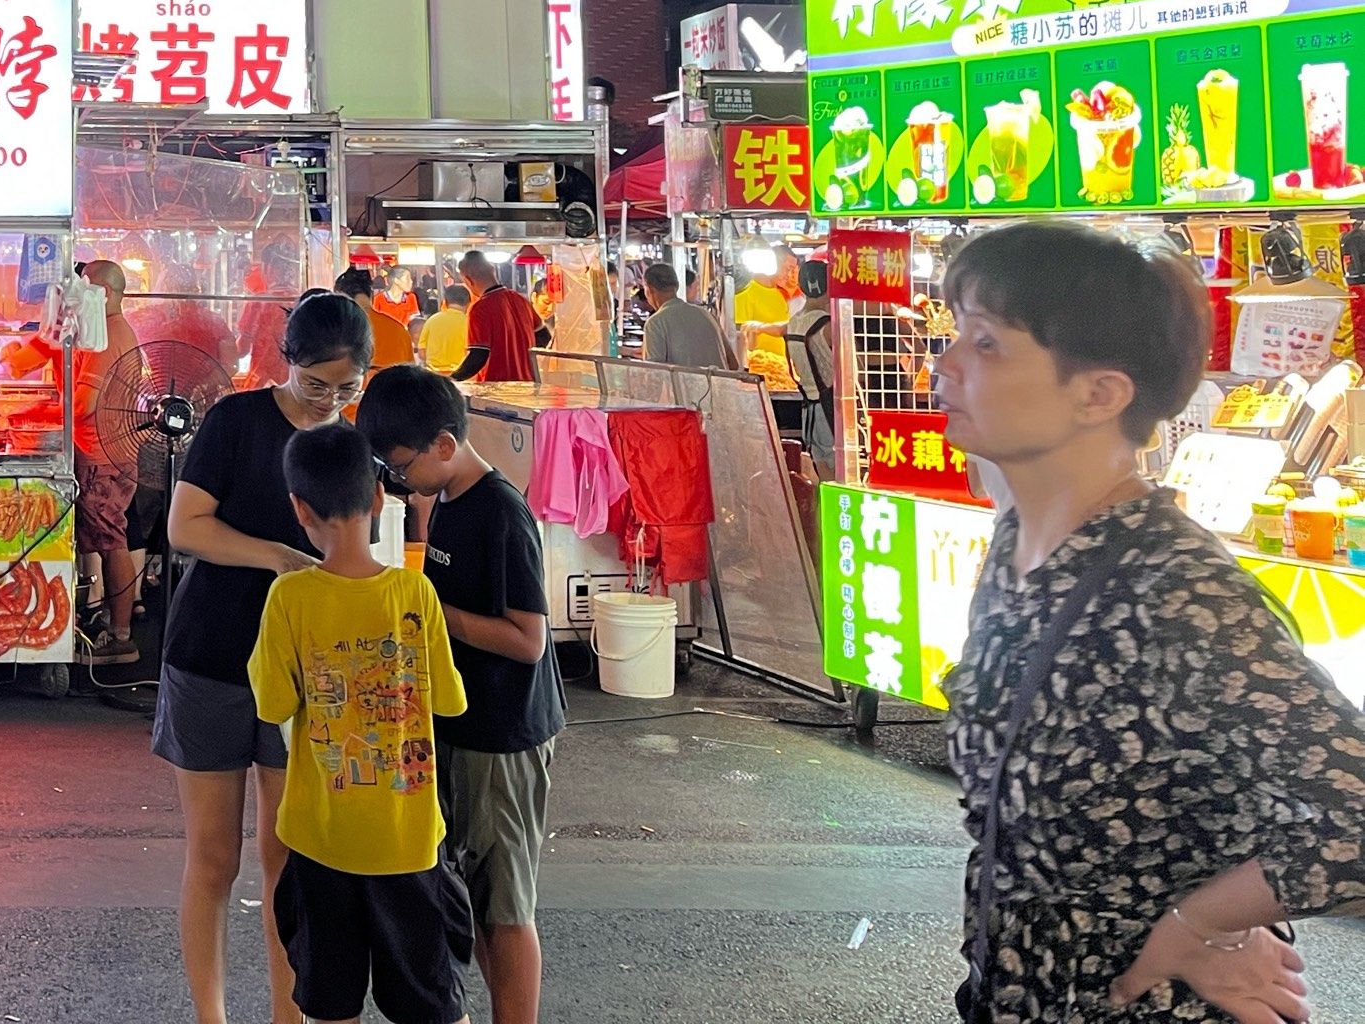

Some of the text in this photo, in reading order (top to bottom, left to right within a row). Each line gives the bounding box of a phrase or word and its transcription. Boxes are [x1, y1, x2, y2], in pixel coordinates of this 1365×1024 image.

[975, 0, 1249, 46] NICE 糖小苏的摊儿 其他的想到再说
[733, 127, 807, 208] 铁
[832, 246, 907, 288] 冰藕粉
